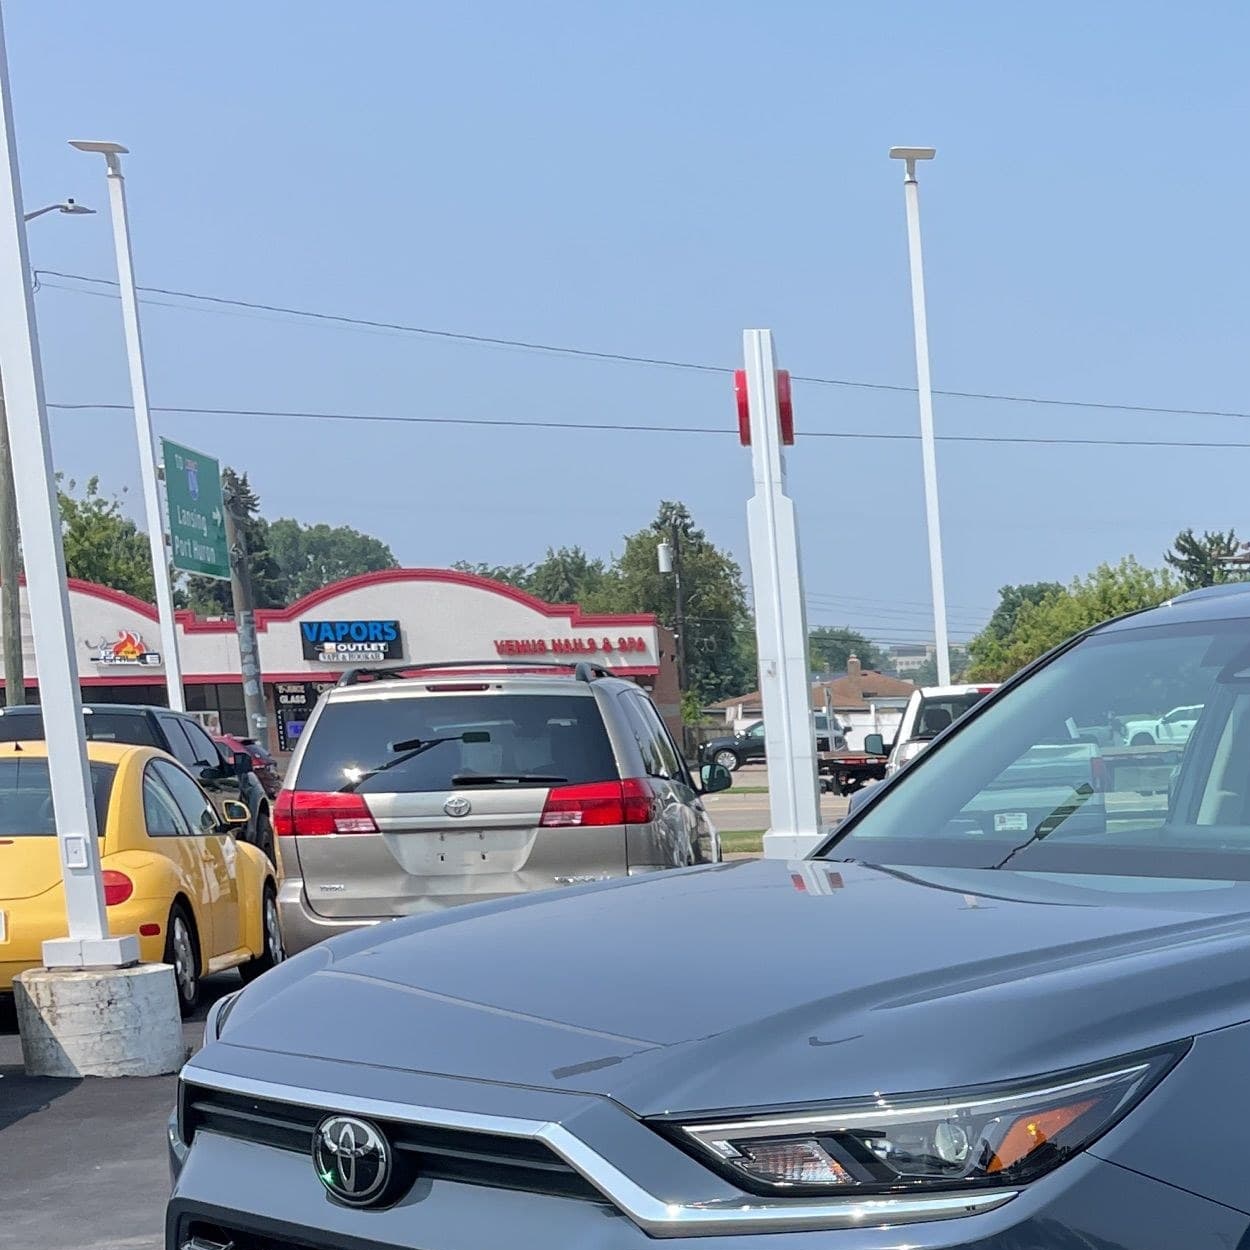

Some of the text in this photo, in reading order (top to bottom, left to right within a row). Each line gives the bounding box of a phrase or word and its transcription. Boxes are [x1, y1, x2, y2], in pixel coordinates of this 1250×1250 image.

[175, 535, 193, 558] Port
[303, 622, 398, 641] VAPORS
[337, 642, 387, 652] OUTLET
[494, 639, 546, 656] VENUS
[552, 637, 597, 655] NAILS
[618, 636, 647, 653] SPA
[280, 695, 306, 704] GLASS
